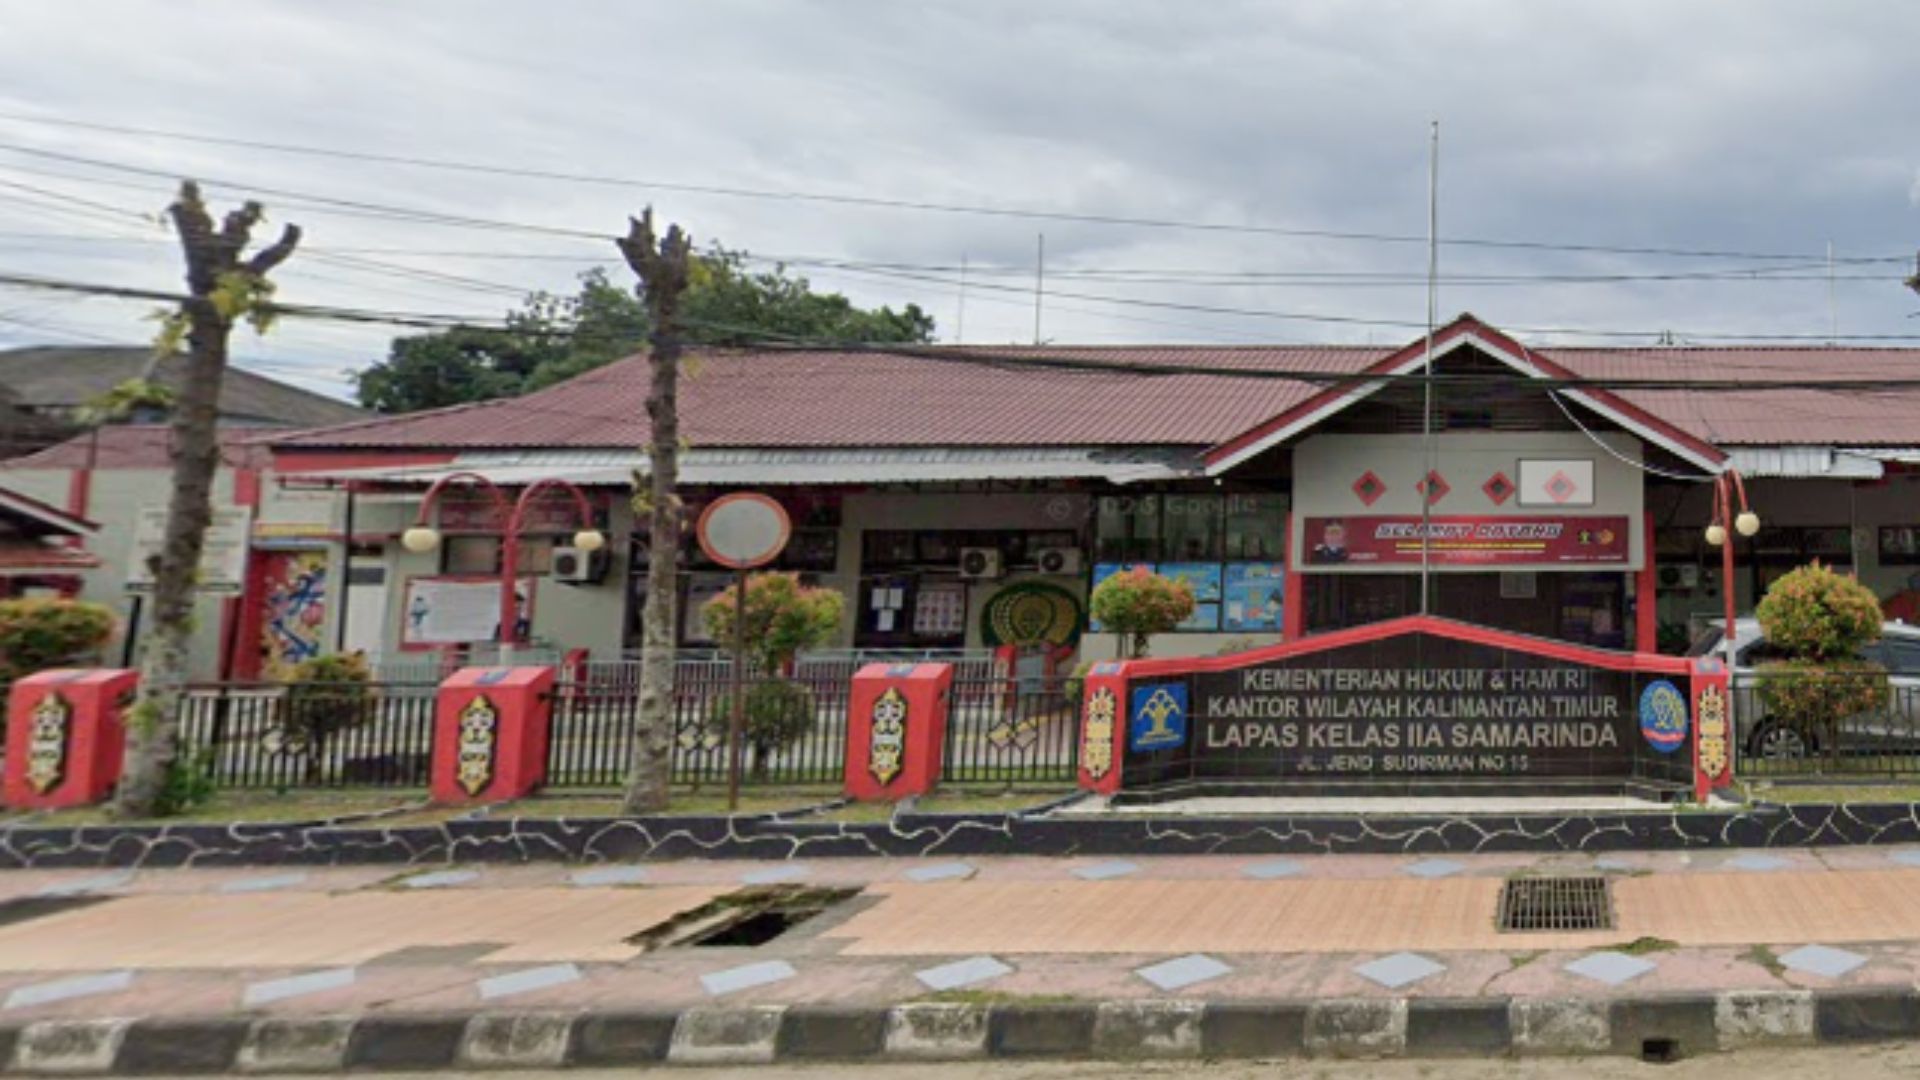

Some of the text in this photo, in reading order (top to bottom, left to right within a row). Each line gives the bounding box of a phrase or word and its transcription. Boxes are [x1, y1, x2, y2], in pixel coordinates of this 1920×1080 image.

[1243, 669, 1586, 690] KEMENTERIAN HUKUM & HAM RI
[1207, 696, 1619, 717] KANTOR WILAYAH KALIMANTAN TIMUR
[1207, 723, 1299, 748] LAPAS
[1307, 723, 1401, 748] KELAS
[1407, 723, 1445, 748] IIA
[1451, 723, 1618, 748] SAMARINDA
[1383, 755, 1474, 771] SUDIRMAN
[1509, 755, 1528, 771] 15
